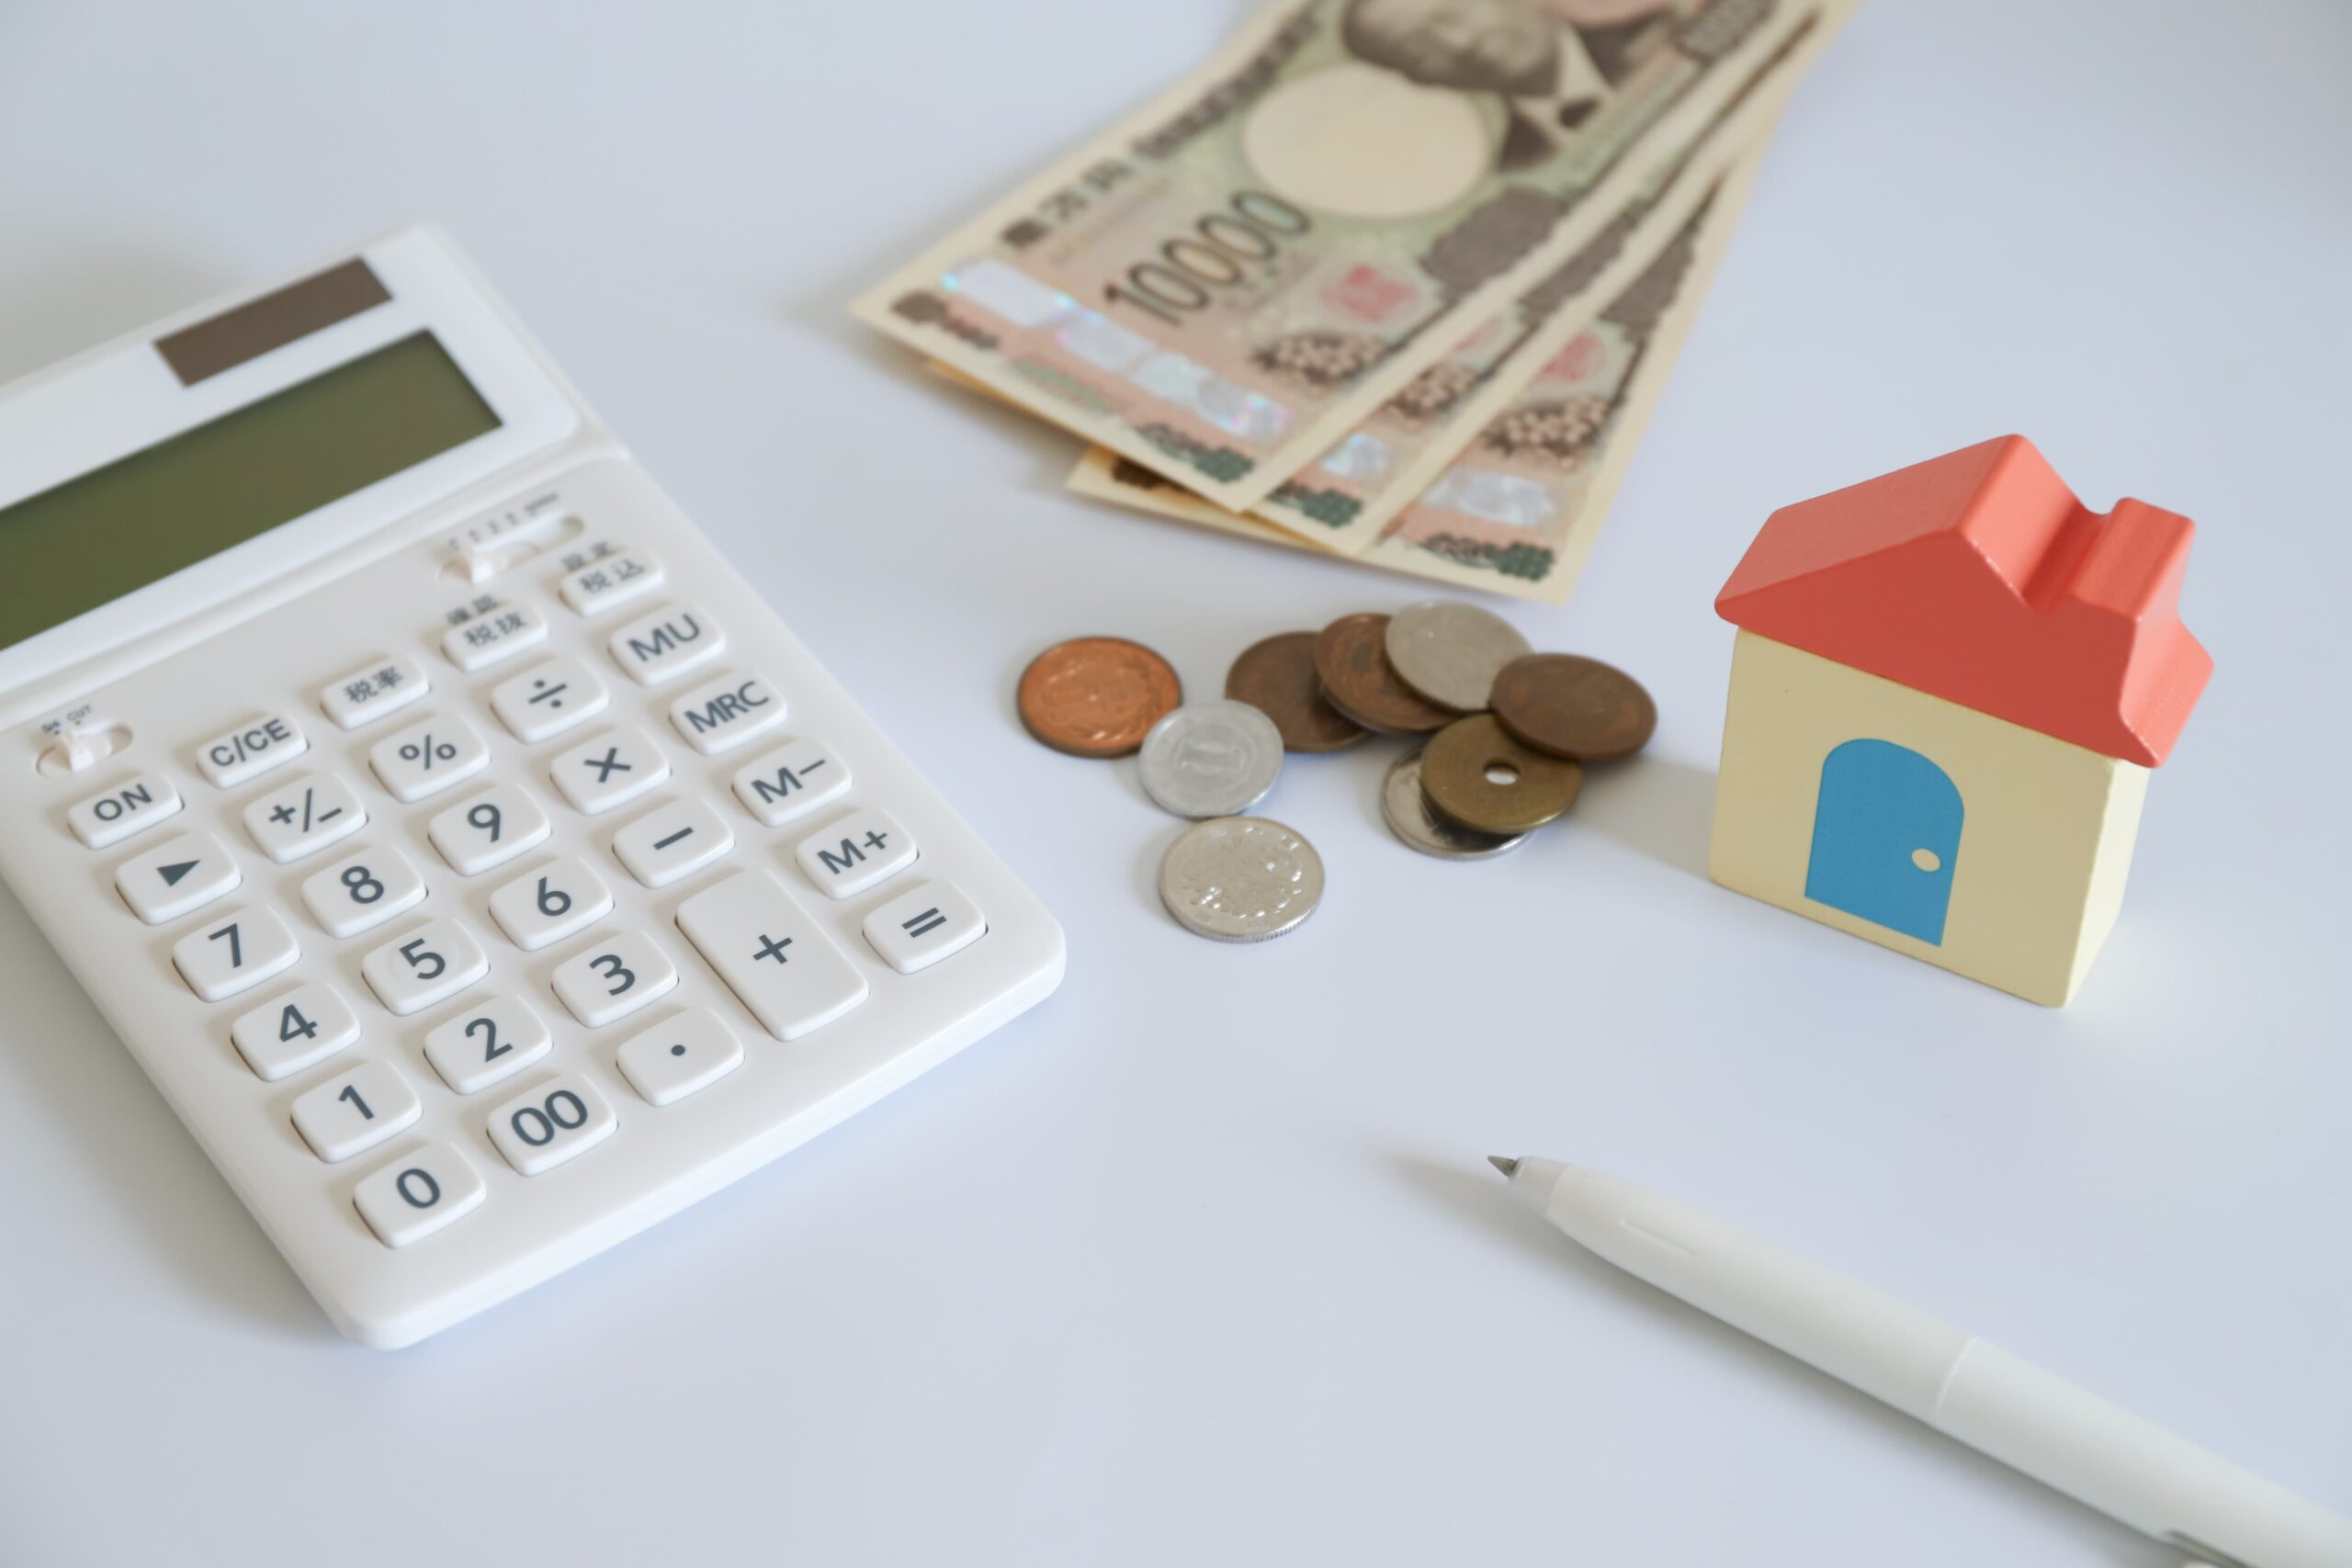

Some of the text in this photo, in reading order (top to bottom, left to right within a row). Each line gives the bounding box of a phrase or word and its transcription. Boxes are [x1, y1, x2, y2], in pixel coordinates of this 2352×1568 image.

[1104, 189, 1311, 327] 10000
[628, 614, 700, 661] MU
[345, 667, 402, 703] 税率
[529, 680, 567, 708] ÷
[684, 681, 769, 733] MRC
[209, 718, 290, 766] C/CE
[399, 735, 457, 770] %
[94, 784, 153, 821] ON
[468, 804, 501, 842] 9
[817, 831, 887, 874] M+
[341, 866, 384, 904] 8
[537, 877, 571, 916] 6
[902, 908, 946, 938] =
[209, 923, 242, 968] 7
[400, 938, 446, 979] 5
[753, 934, 792, 964] +
[590, 954, 635, 996] 3
[279, 1004, 317, 1042] 4
[465, 1018, 513, 1062] 2
[339, 1085, 374, 1120] 1
[511, 1090, 588, 1146] 00
[396, 1168, 440, 1209] 0
